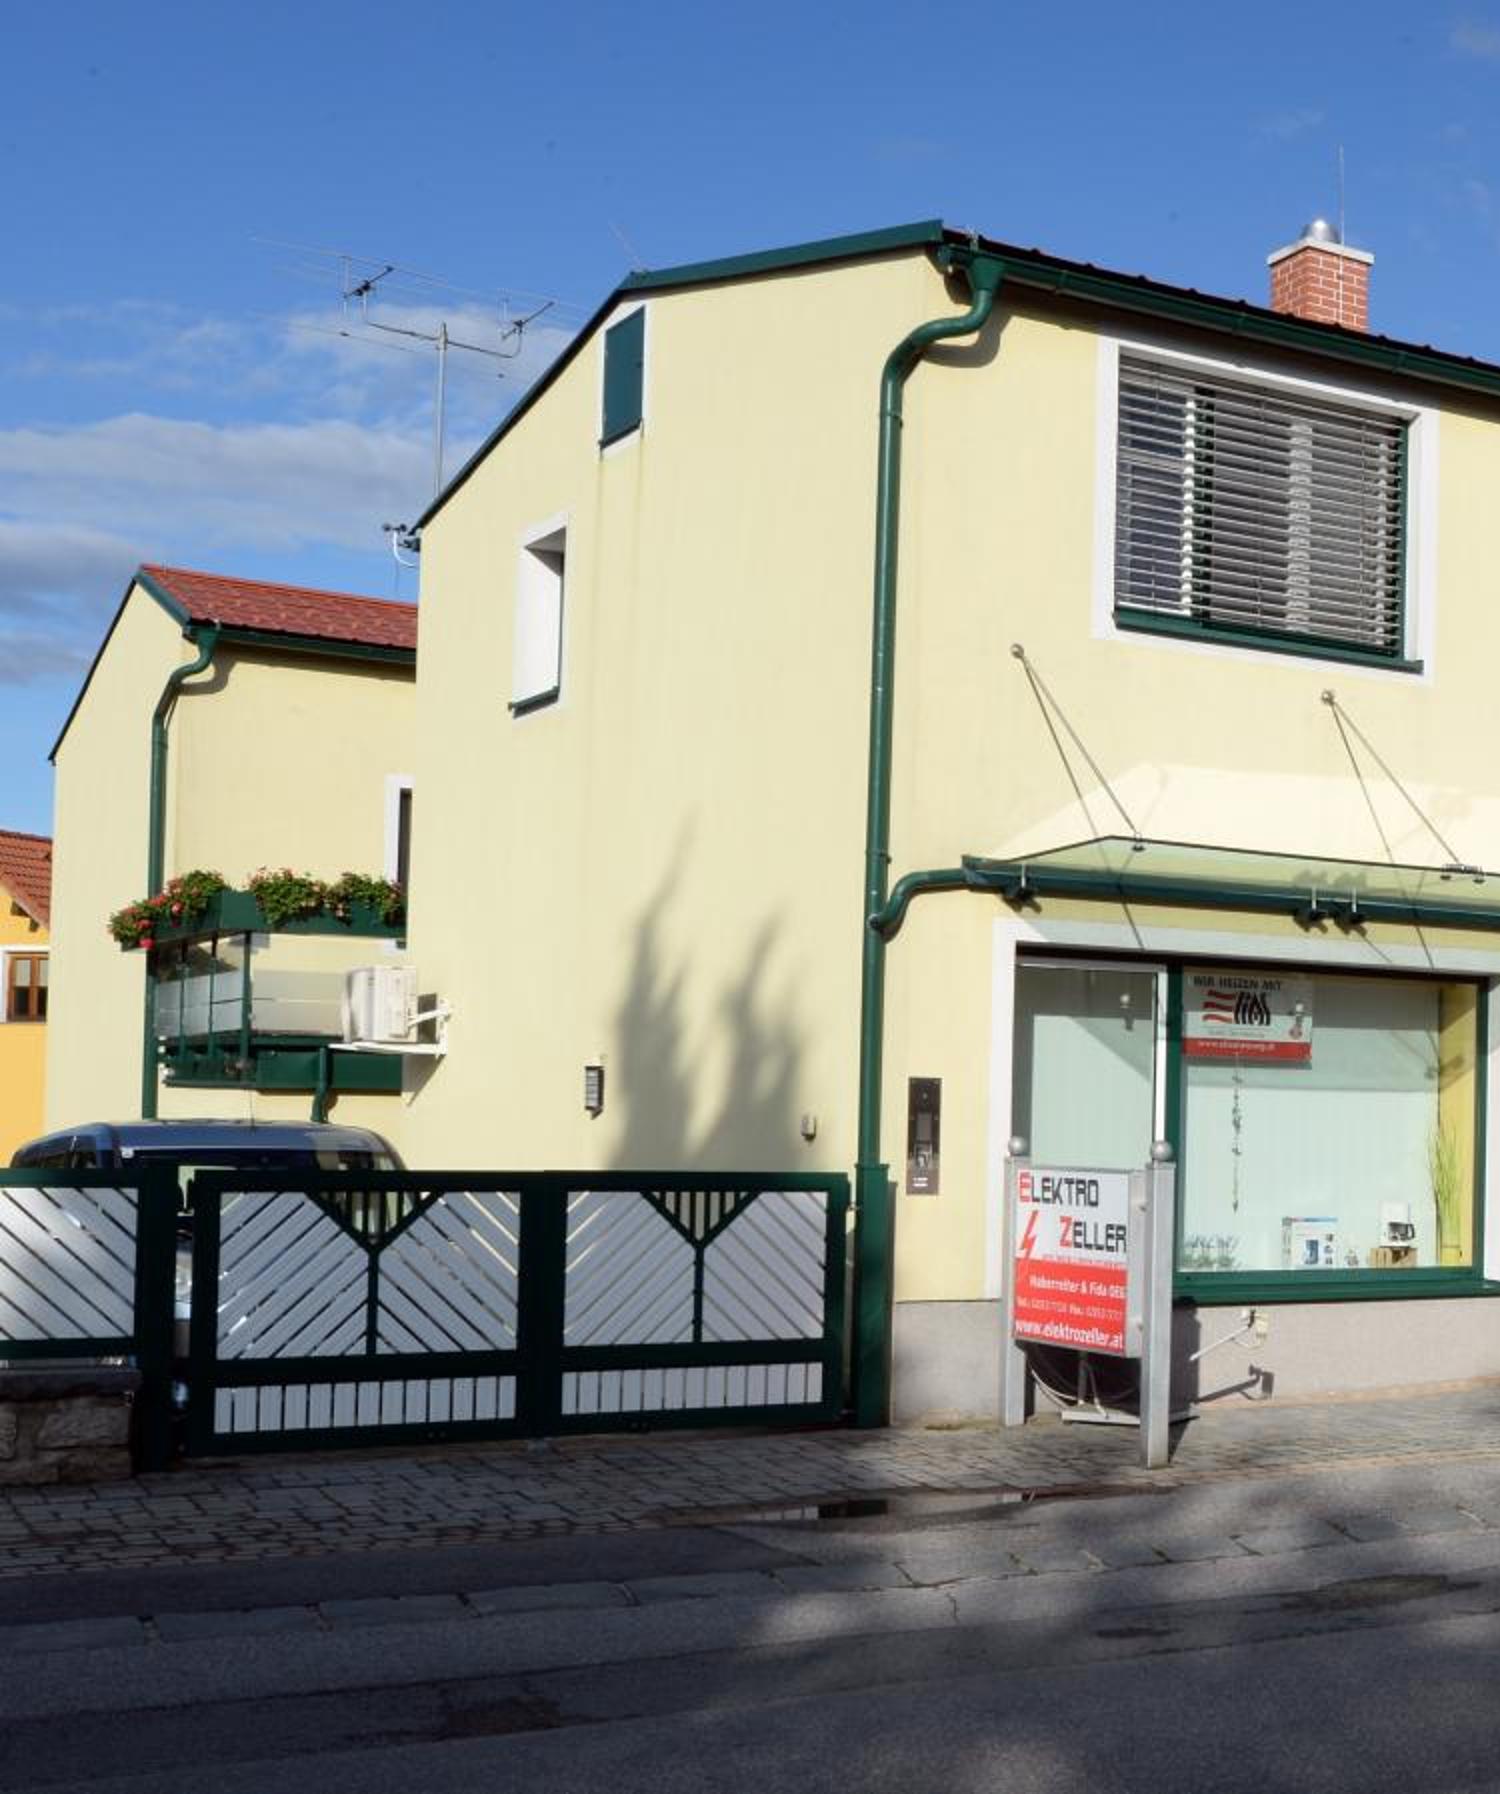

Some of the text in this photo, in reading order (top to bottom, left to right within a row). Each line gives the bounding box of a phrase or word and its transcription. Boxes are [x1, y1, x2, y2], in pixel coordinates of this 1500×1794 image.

[1219, 977, 1260, 990] HEIZEN
[1019, 1172, 1099, 1207] ELEKTRO
[1060, 1216, 1127, 1253] ZELLER
[1015, 1319, 1124, 1349] www.elektrozeller.at
